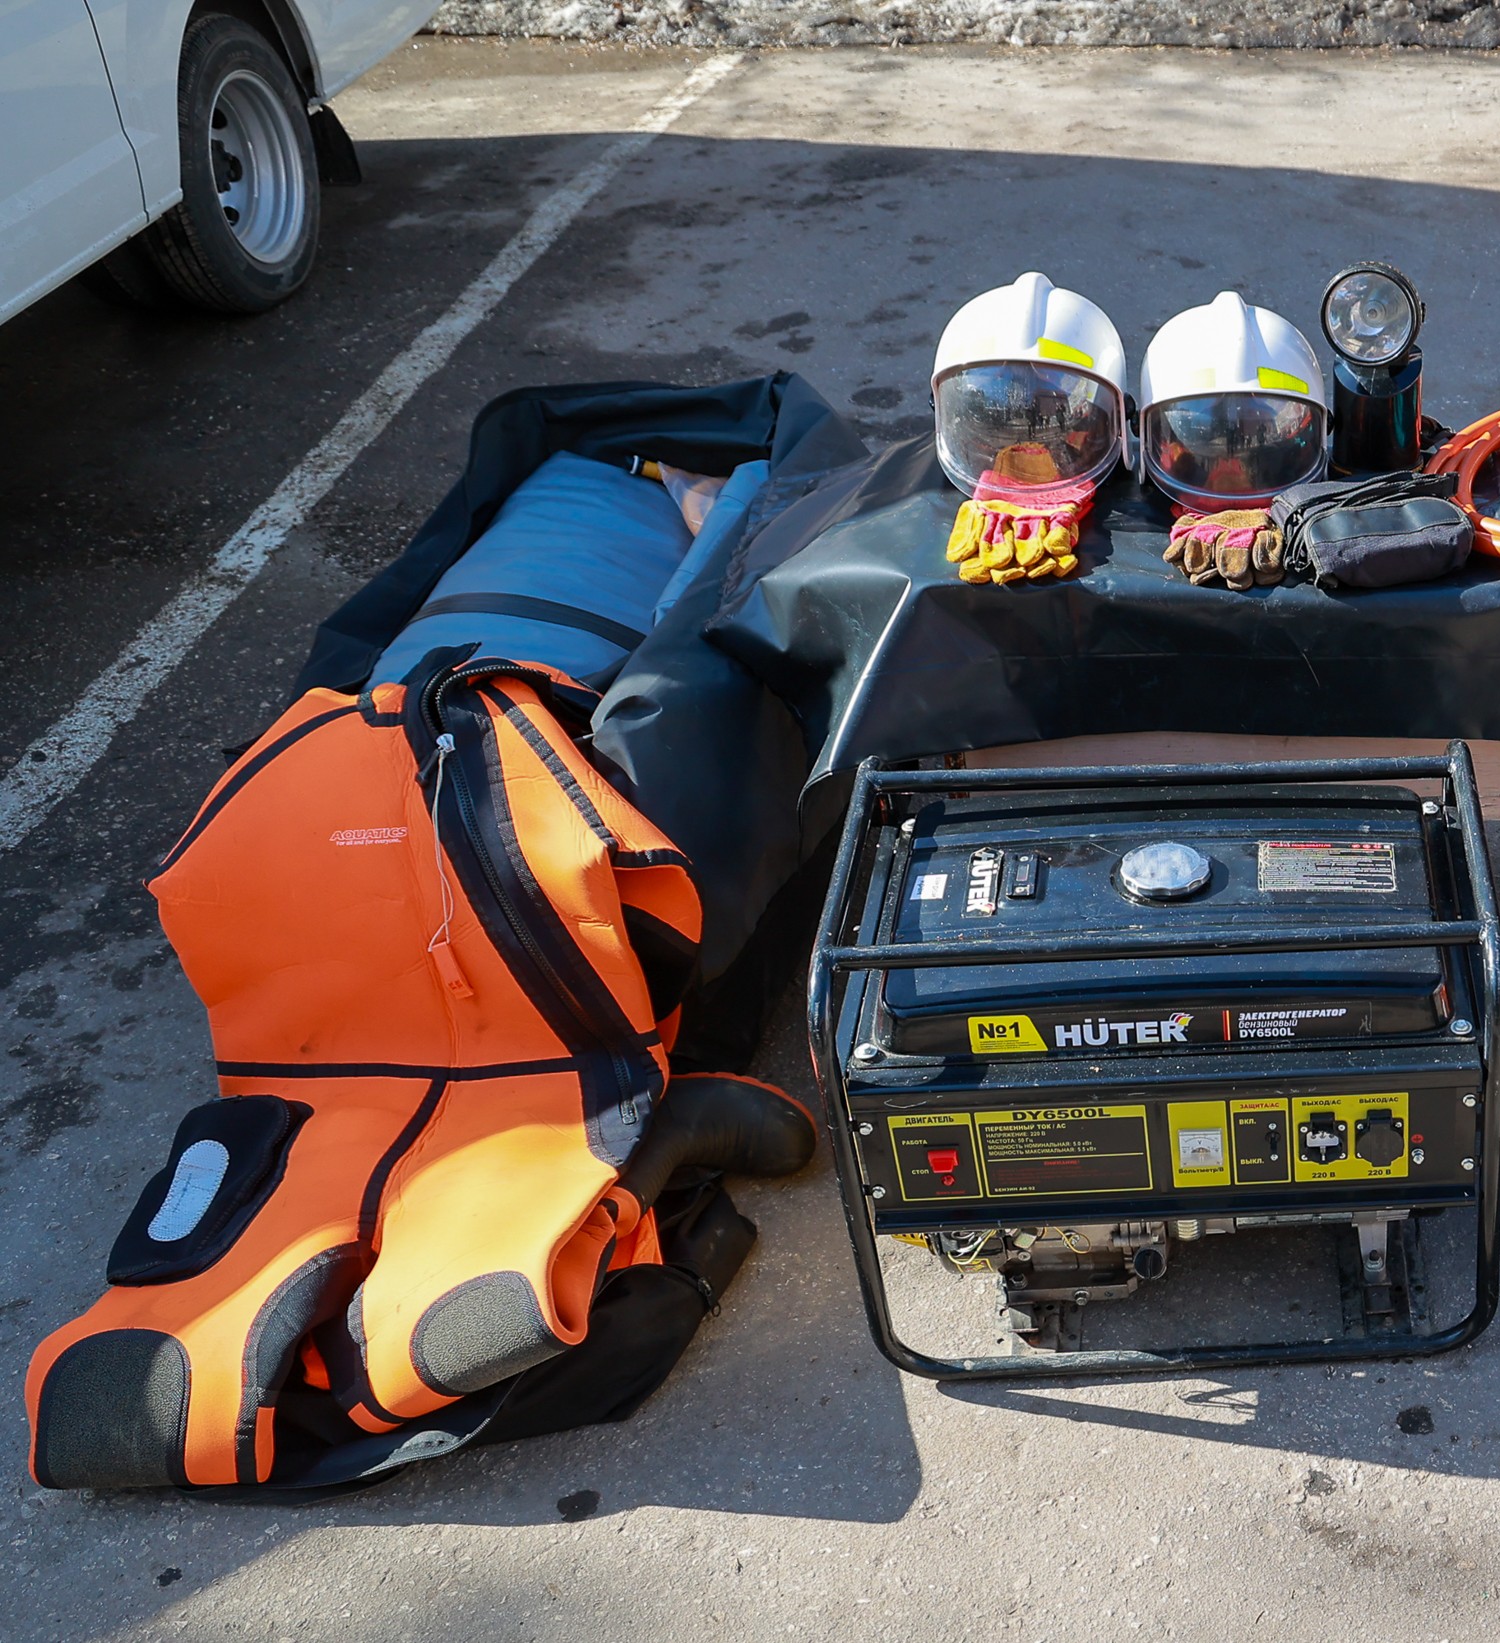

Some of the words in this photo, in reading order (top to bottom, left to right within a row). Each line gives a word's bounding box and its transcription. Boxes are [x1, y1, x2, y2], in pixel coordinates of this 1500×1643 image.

[328, 827, 408, 841] AQUATICS
[966, 851, 998, 912] HÜTER
[1238, 1008, 1347, 1021] ЭЛЕКТРОГЕНЕРАТОР
[1238, 1018, 1298, 1029] бензиновый
[977, 1022, 1021, 1039] №1
[1054, 1017, 1187, 1047] HÜTER
[1239, 1028, 1295, 1038] DY6500L
[905, 1115, 954, 1125] ДВИГАТЕЛЬ
[1012, 1107, 1111, 1122] DY6500L
[985, 1124, 1035, 1132] ПЕРЕМЕННЫЙ
[1025, 1147, 1076, 1155] МАКСИМАЛЬНАЯ:
[1178, 1166, 1224, 1174] Вольтметр/В
